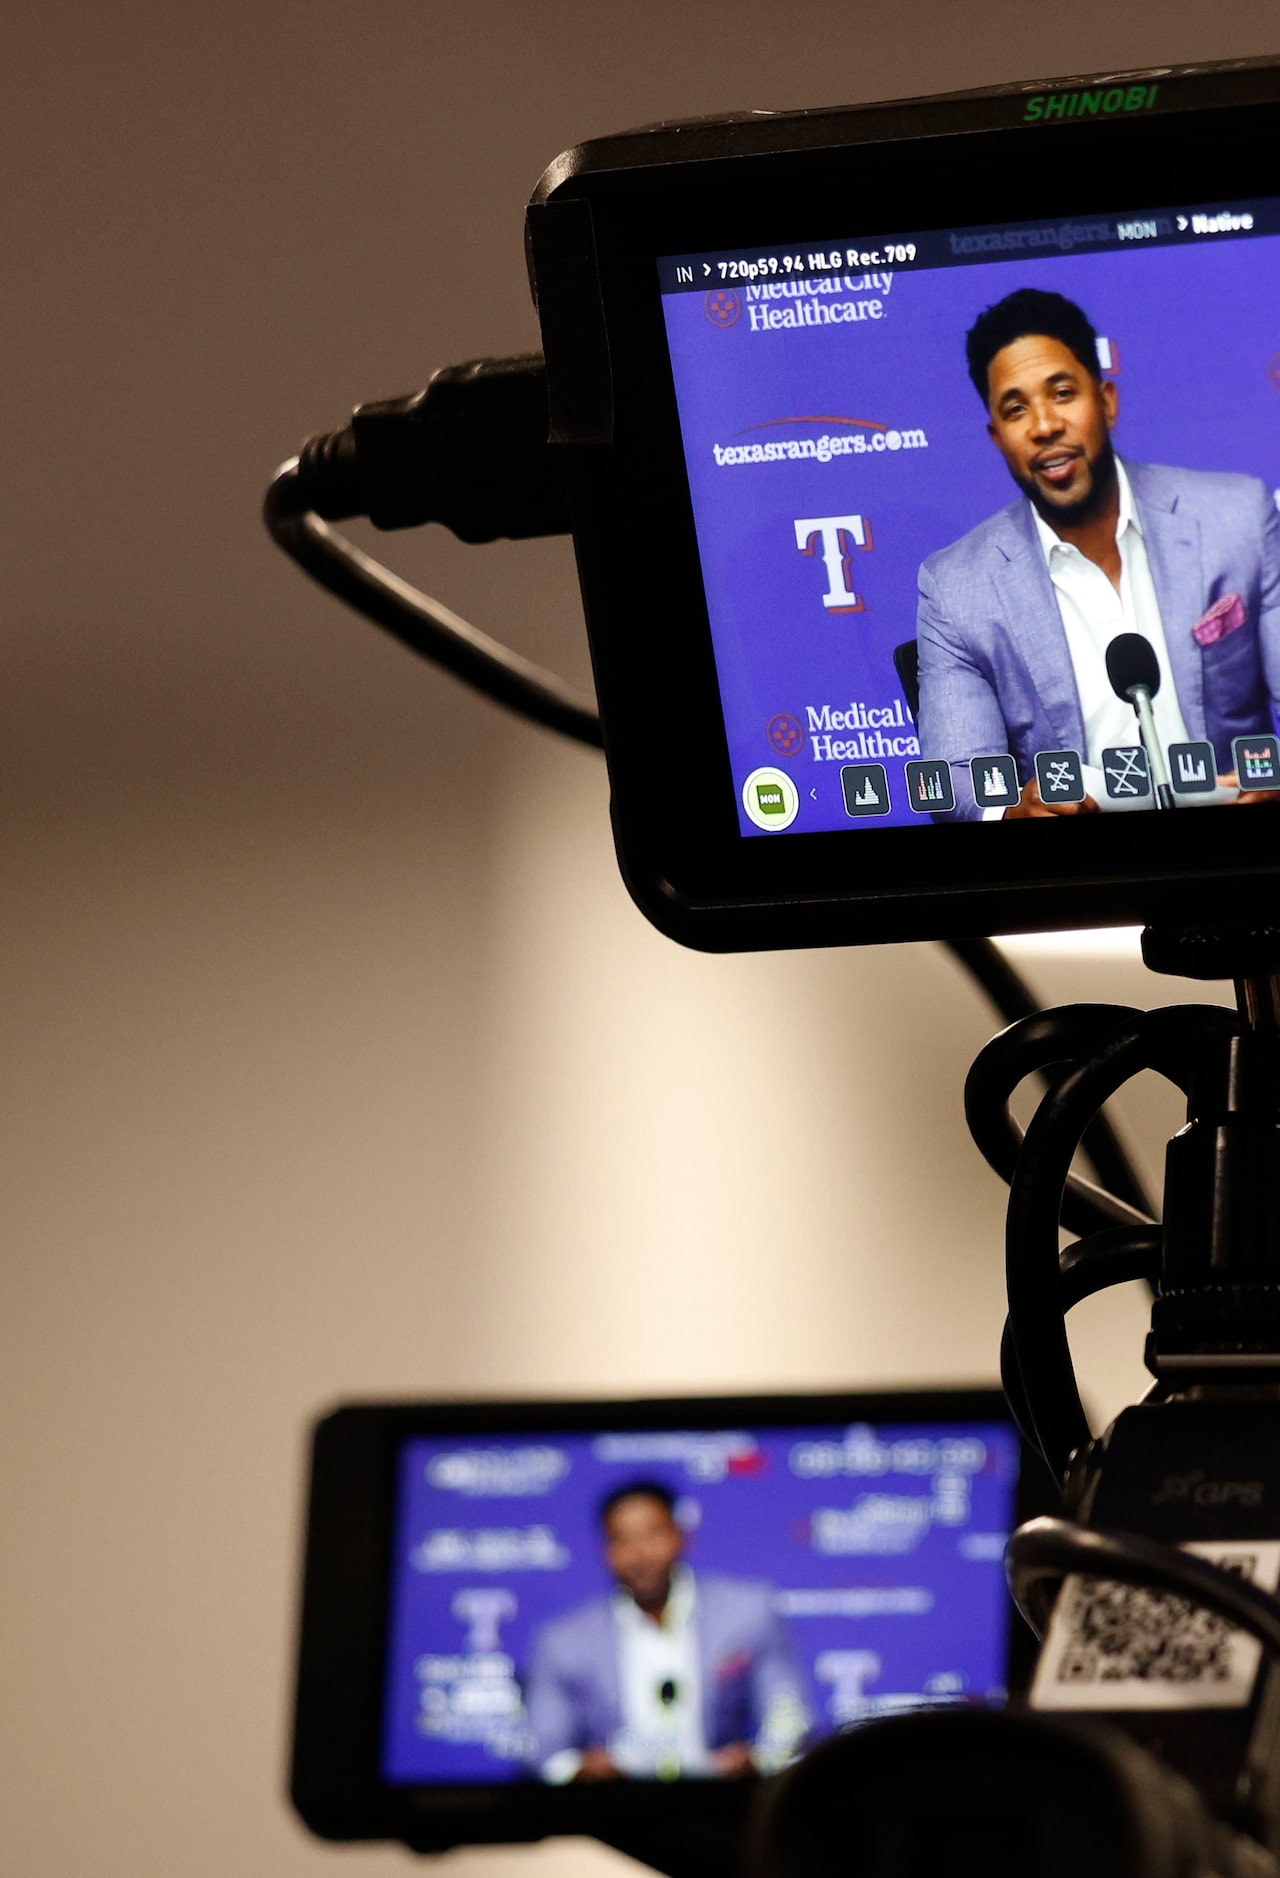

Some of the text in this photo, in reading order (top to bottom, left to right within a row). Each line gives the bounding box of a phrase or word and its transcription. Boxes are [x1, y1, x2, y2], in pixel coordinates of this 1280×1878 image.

[1023, 84, 1159, 122] SHINOBI
[1117, 211, 1254, 245] MON Native
[676, 244, 917, 283] IN 720p59.94 HLG Rec.709
[746, 266, 894, 302] Medical City
[713, 427, 928, 467] texasrangers.com
[794, 515, 874, 614] T
[805, 698, 905, 732] Medical
[810, 730, 921, 762] Healthca
[760, 793, 781, 804] MON
[1192, 1481, 1264, 1506] GPS
